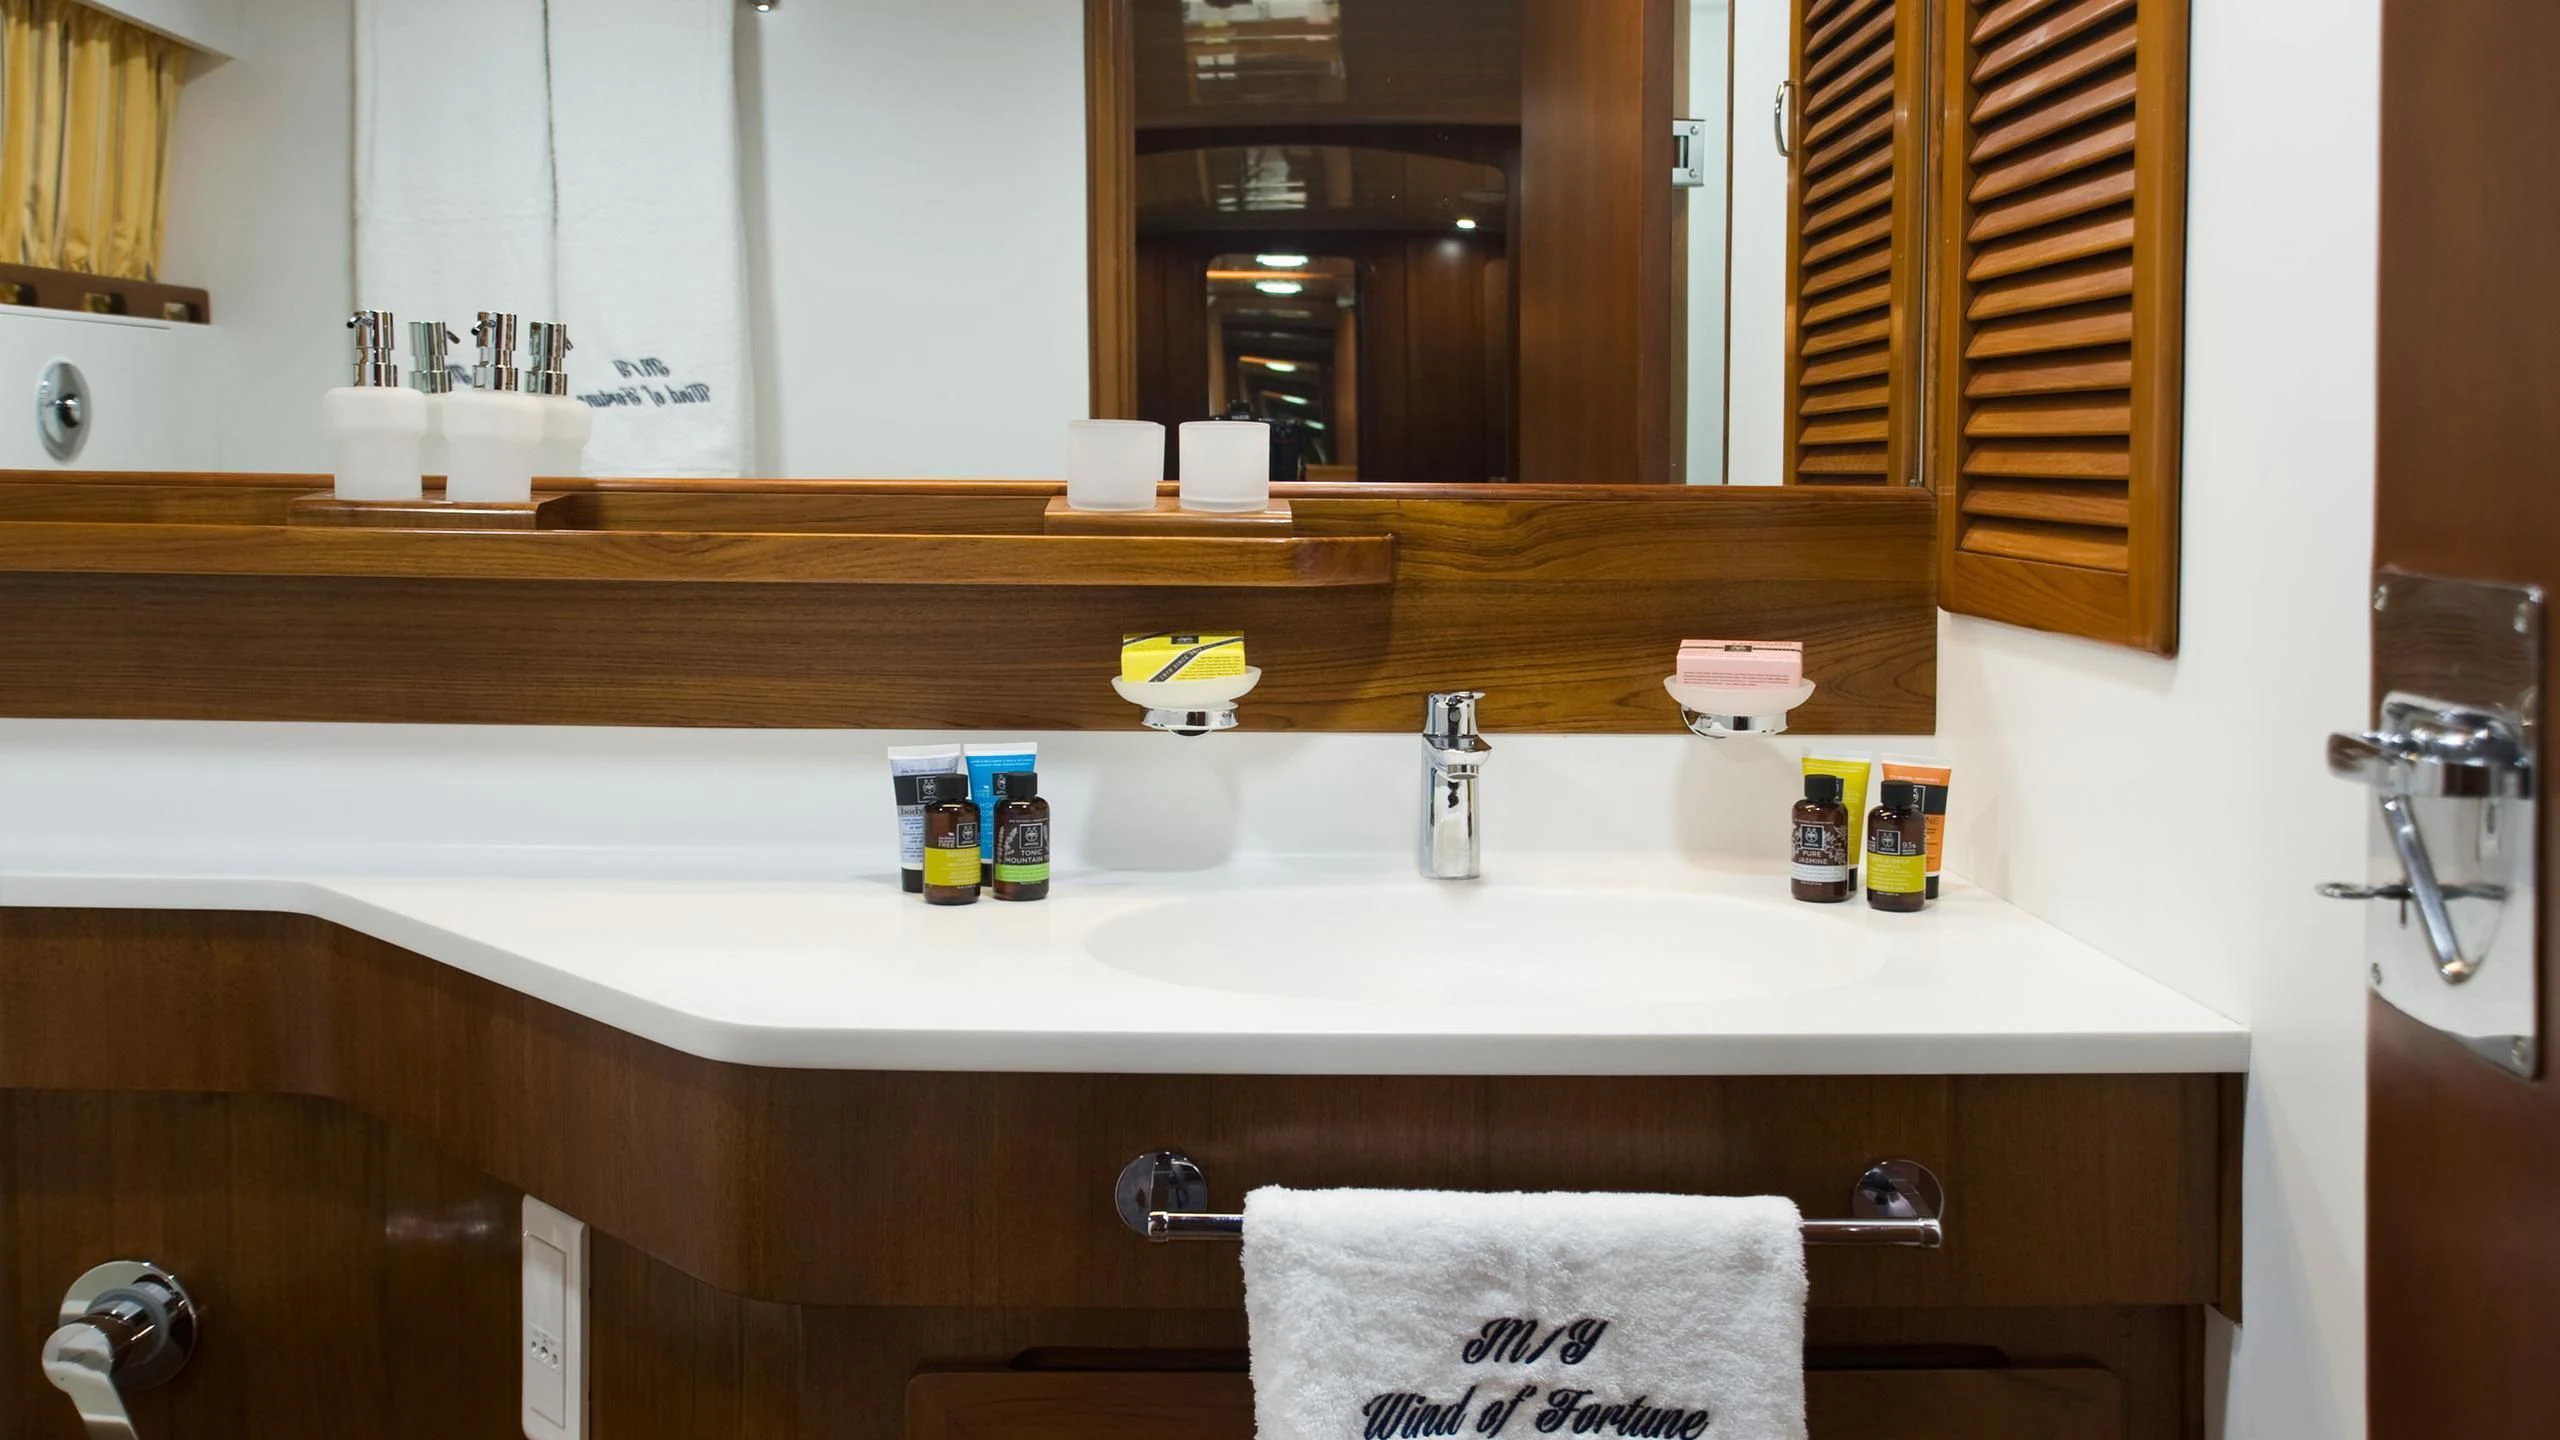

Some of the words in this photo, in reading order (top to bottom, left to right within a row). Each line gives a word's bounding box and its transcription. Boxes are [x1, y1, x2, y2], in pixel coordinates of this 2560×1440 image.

[1005, 856, 1043, 864] MOUNTAIN
[1798, 857, 1829, 865] JASMINE
[1461, 1317, 1609, 1365] M/Y
[1362, 1385, 1478, 1440] Wind
[1476, 1385, 1538, 1439] of
[1535, 1388, 1710, 1440] Fortune
